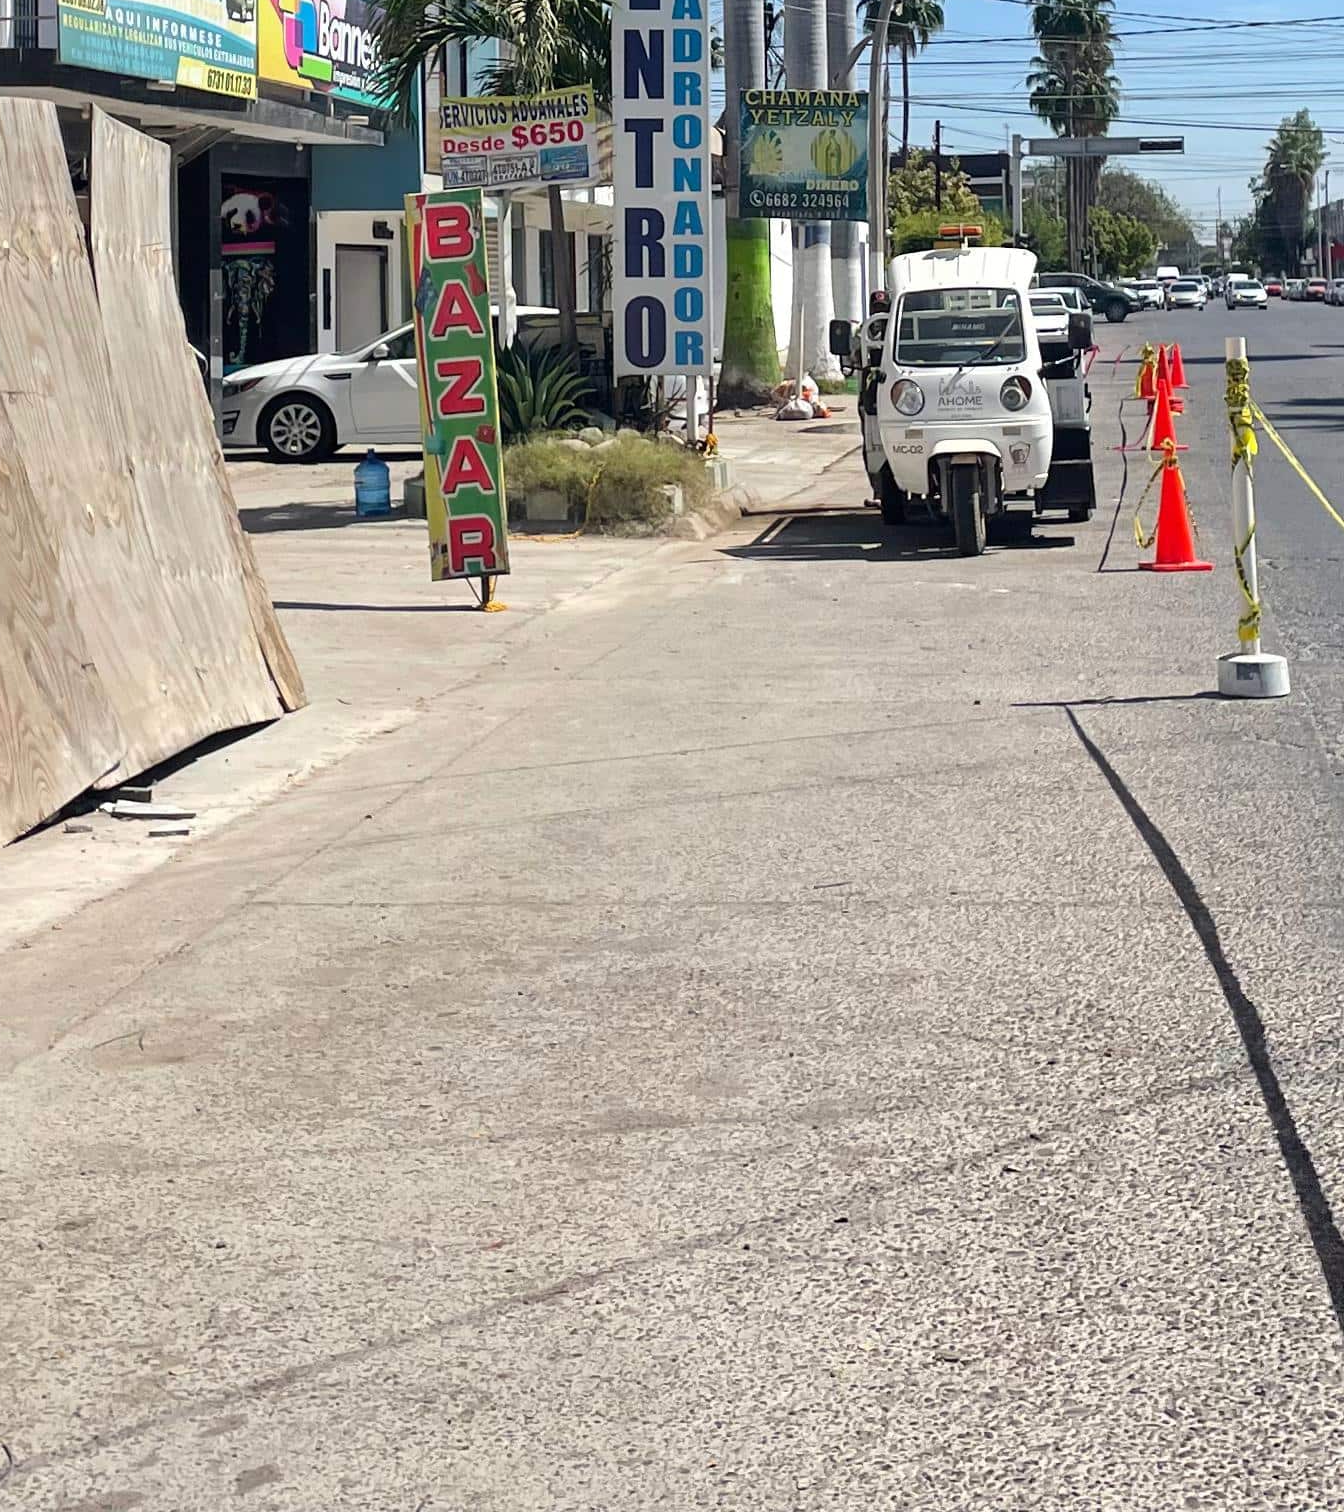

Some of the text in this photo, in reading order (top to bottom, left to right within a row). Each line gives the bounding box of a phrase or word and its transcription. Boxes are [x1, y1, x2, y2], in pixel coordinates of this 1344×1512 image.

[105, 7, 222, 47] AQUI INFORMESE
[512, 93, 589, 123] ADUANALES
[745, 90, 860, 107] CHAMANA
[749, 109, 855, 127] YETZALY
[443, 120, 584, 154] Desde $650
[766, 193, 849, 208] 6682 324964
[423, 202, 498, 574] BAZAR
[937, 395, 984, 407] AHOME
